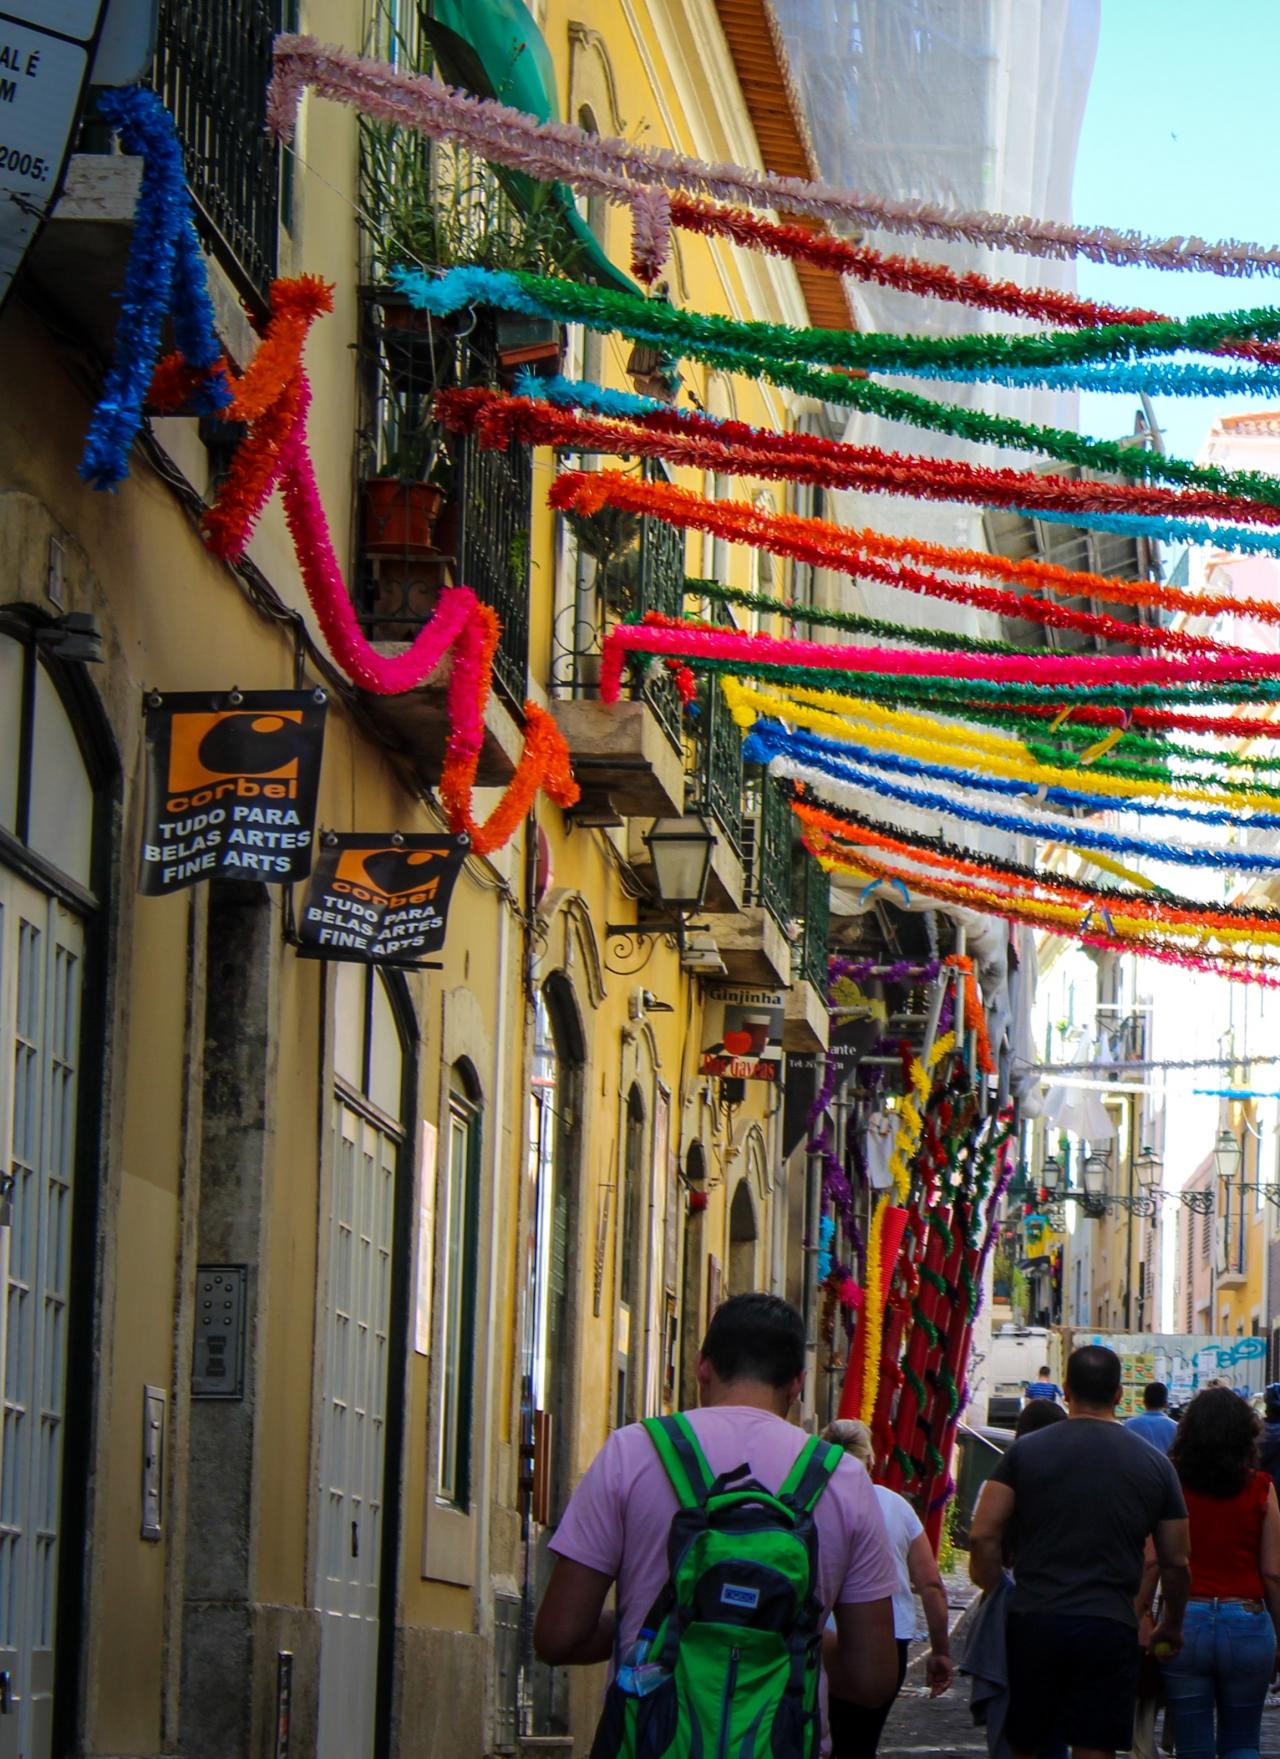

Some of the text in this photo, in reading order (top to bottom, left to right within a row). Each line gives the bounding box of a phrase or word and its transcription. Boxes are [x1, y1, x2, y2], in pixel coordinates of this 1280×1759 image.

[25, 50, 40, 78] É
[0, 146, 49, 182] 2005:
[166, 778, 298, 813] corbel
[159, 806, 301, 839] TUDO PARA
[144, 829, 311, 862] BELAS ARTES
[163, 851, 292, 883] FINE ARTS
[323, 895, 436, 925] TUDO PARA
[331, 882, 438, 909] corbel
[307, 907, 444, 940] BELAS ARTES
[319, 928, 426, 955] FINE ARTS
